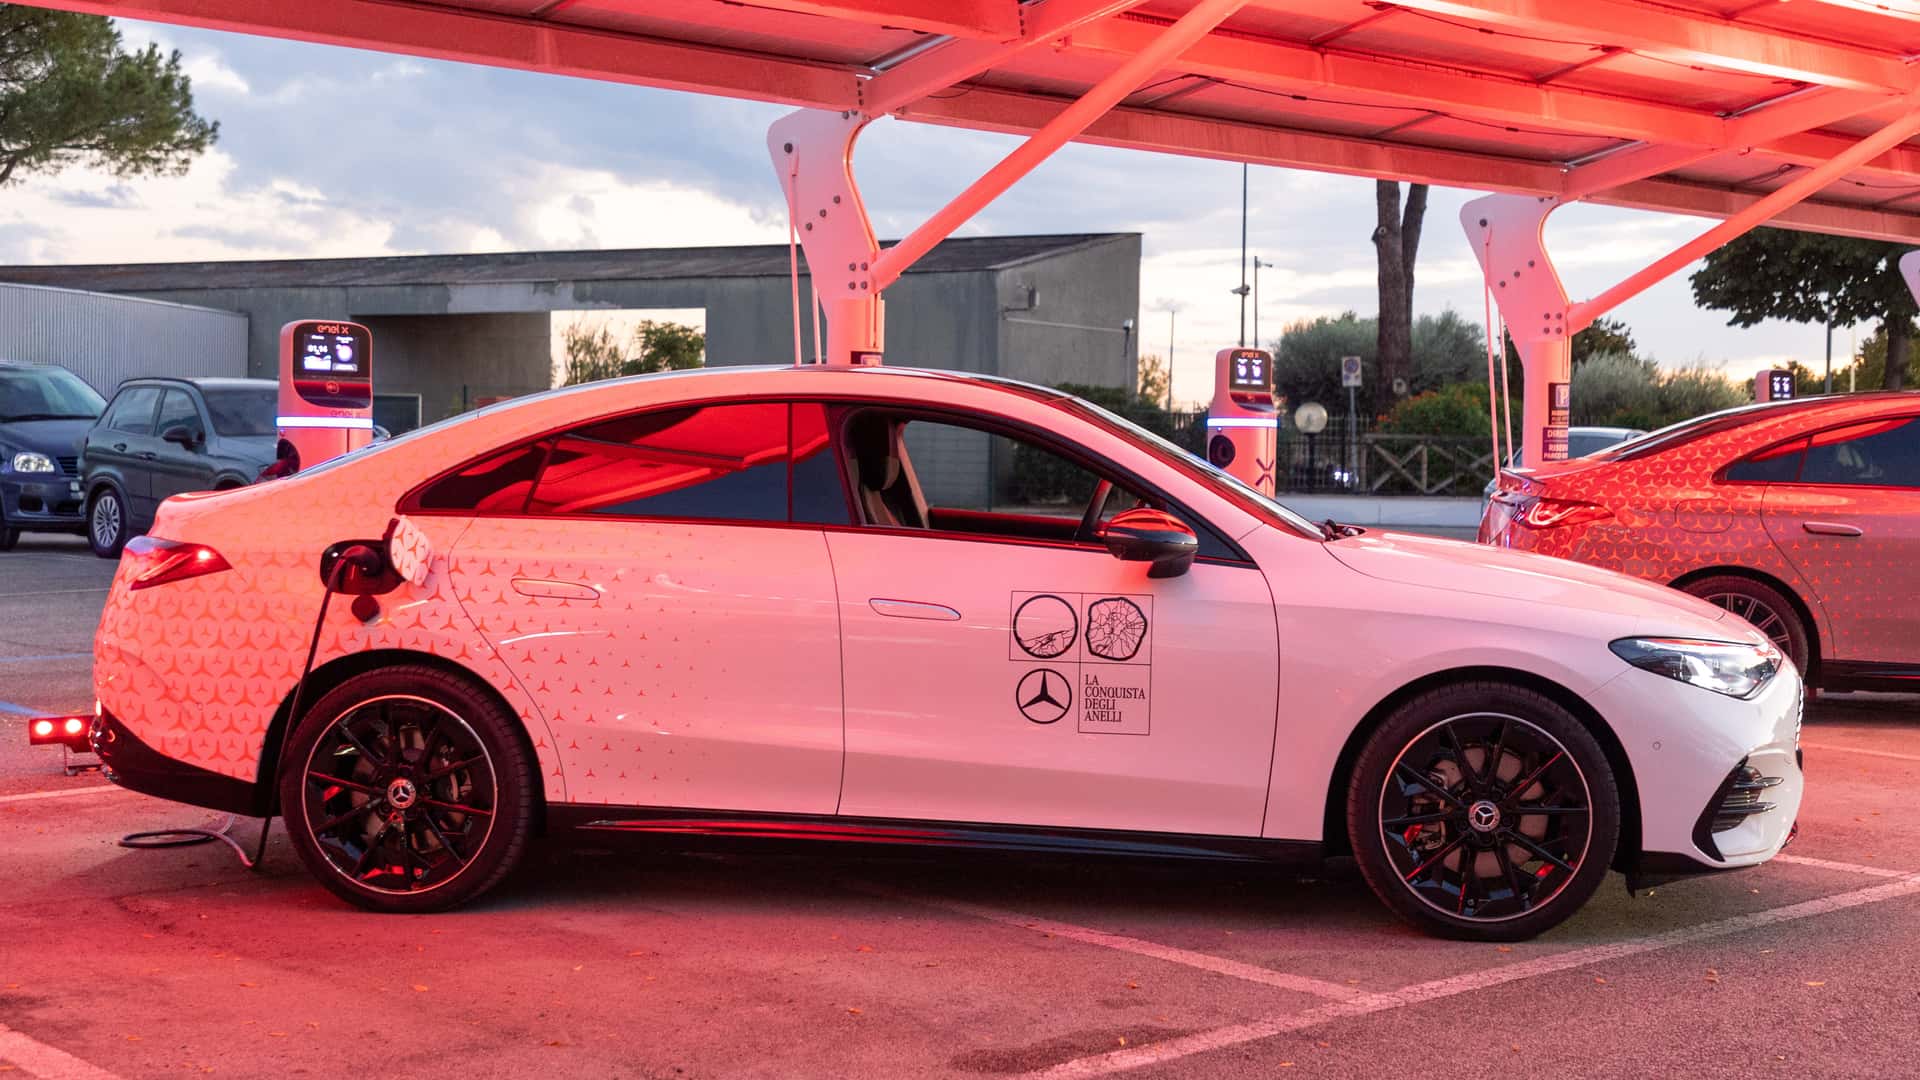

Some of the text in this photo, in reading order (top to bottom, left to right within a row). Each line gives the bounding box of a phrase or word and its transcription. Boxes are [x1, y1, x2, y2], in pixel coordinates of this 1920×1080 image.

[317, 324, 340, 334] enel
[1084, 674, 1100, 686] LA
[1084, 686, 1146, 699] CONQUISTA
[1084, 698, 1116, 710] DEGLI
[1084, 710, 1122, 722] ANELLI
